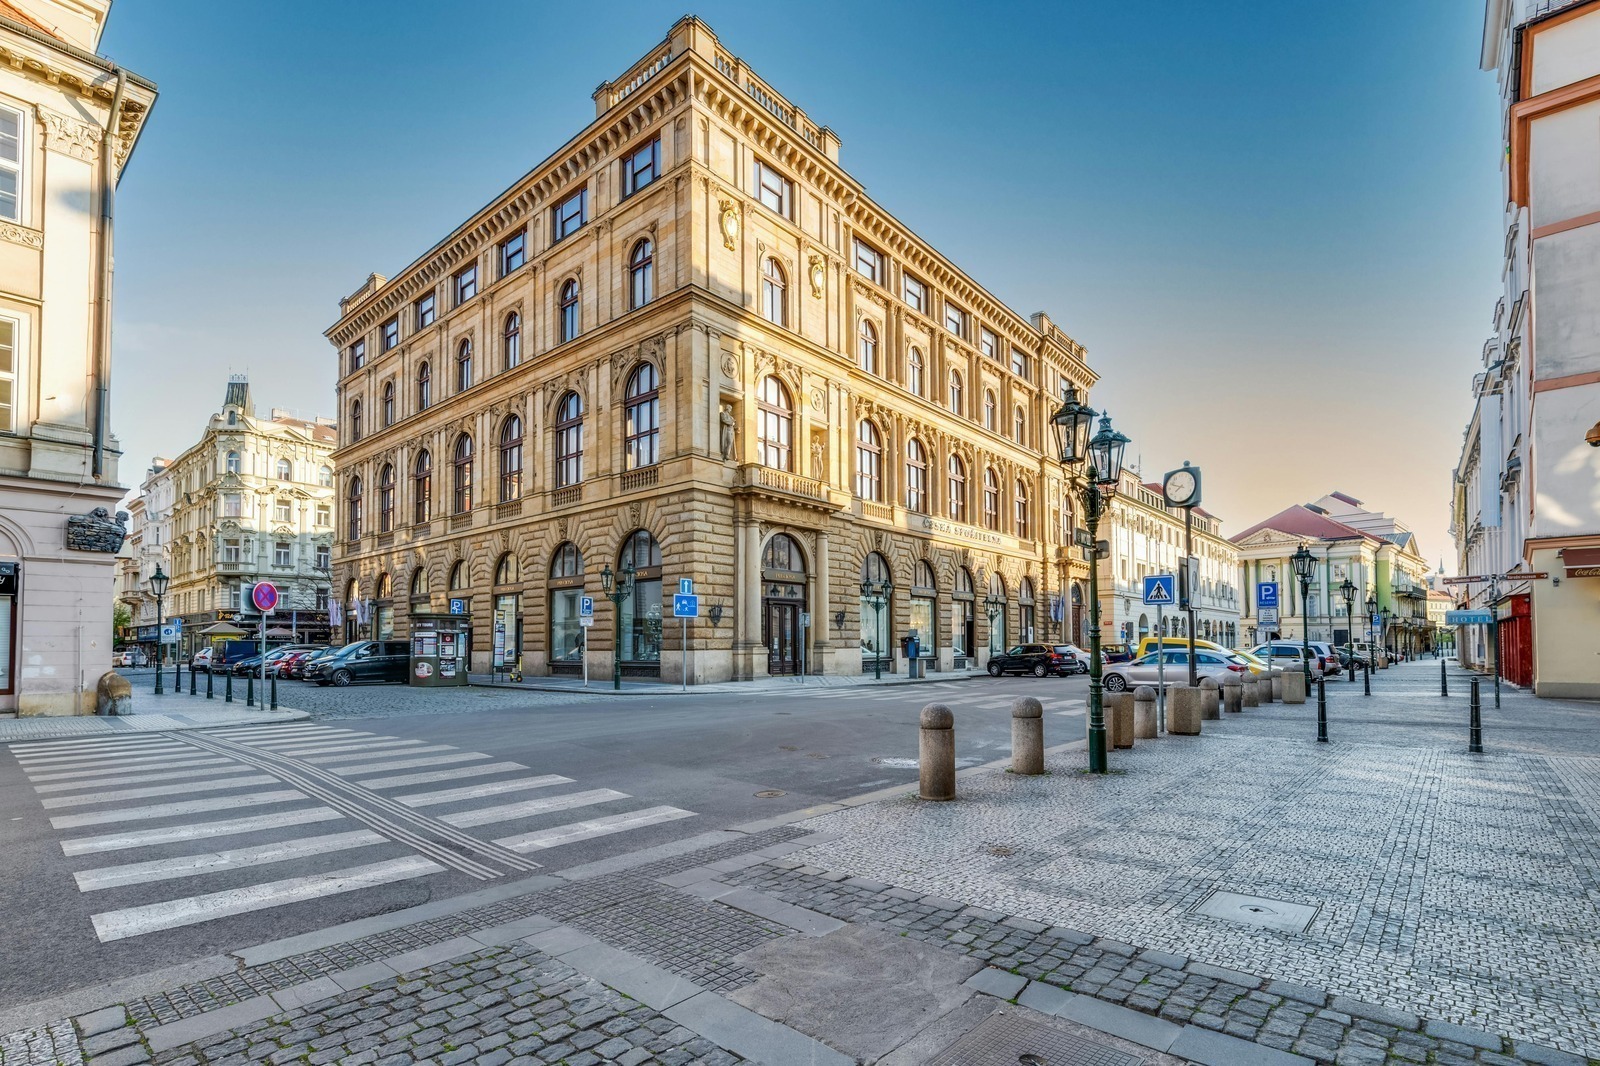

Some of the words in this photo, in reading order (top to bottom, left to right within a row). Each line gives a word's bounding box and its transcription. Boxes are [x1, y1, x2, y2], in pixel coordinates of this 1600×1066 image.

[1261, 585, 1274, 600] P
[583, 598, 590, 608] P
[1452, 615, 1491, 623] HOTEL
